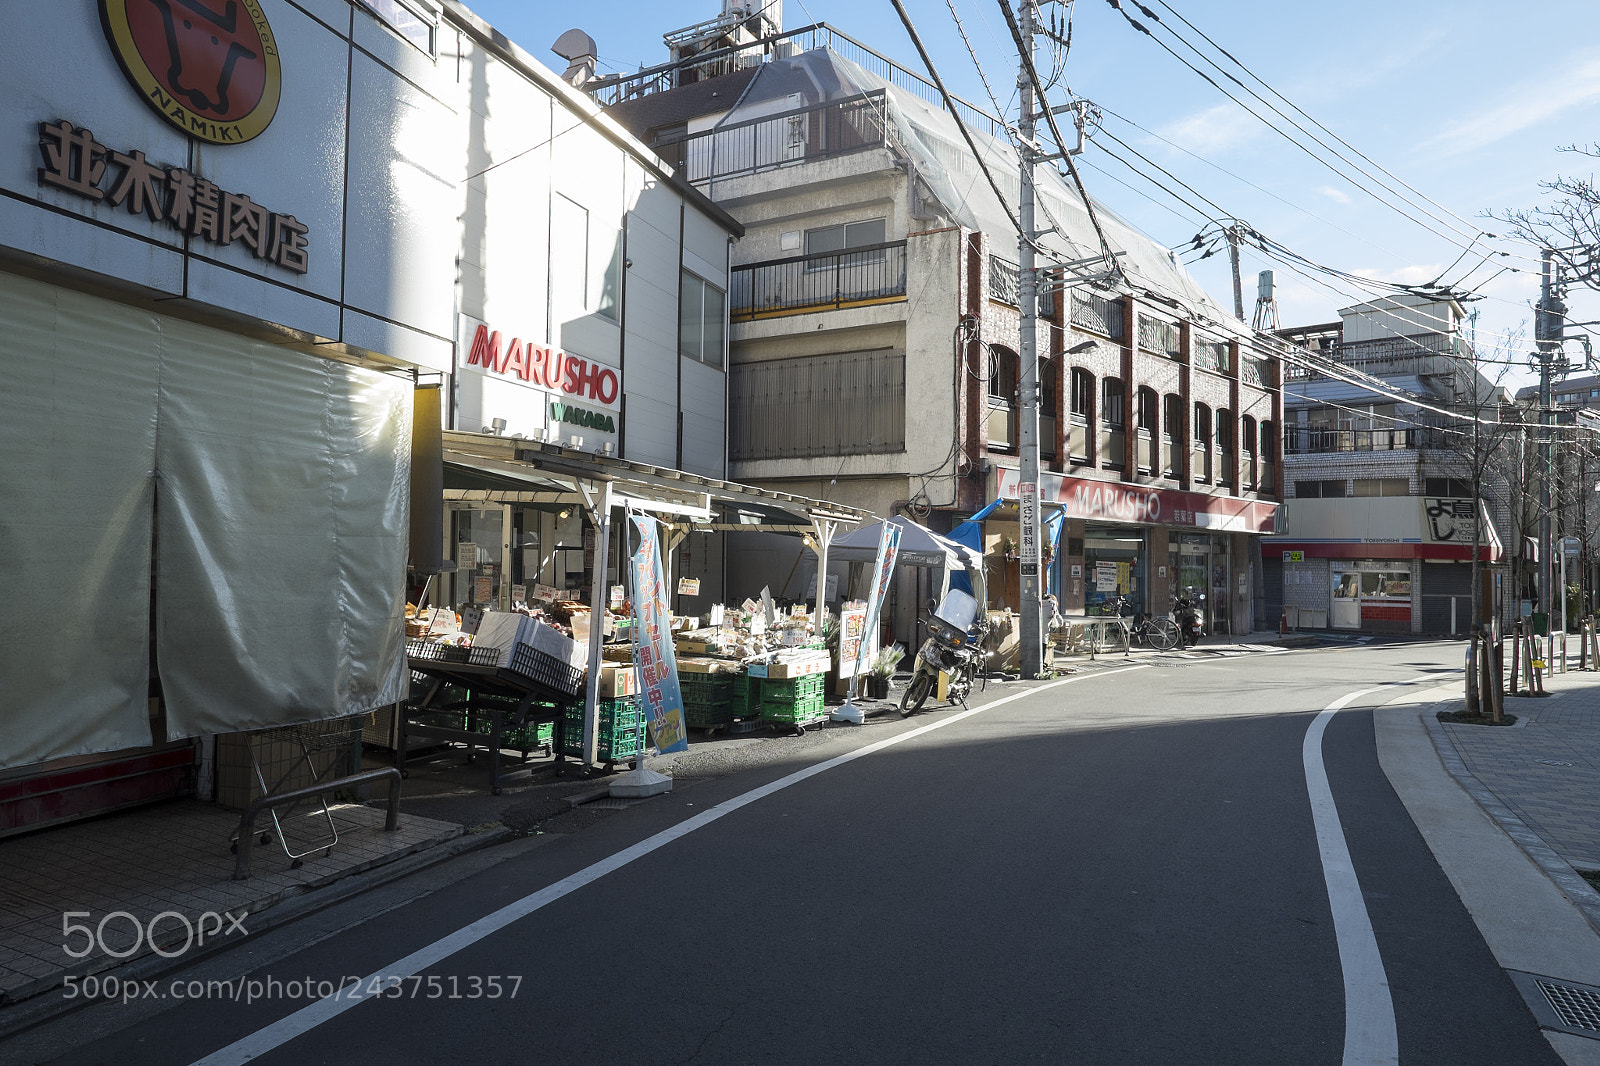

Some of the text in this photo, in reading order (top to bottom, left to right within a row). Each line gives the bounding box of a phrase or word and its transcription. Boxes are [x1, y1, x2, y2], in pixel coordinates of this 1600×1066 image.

[150, 86, 243, 141] NAMIKI
[38, 118, 309, 274] 並木精肉店
[467, 324, 619, 405] MARUSHO
[551, 402, 616, 434] WAKABA
[1073, 485, 1161, 520] MARUSHO
